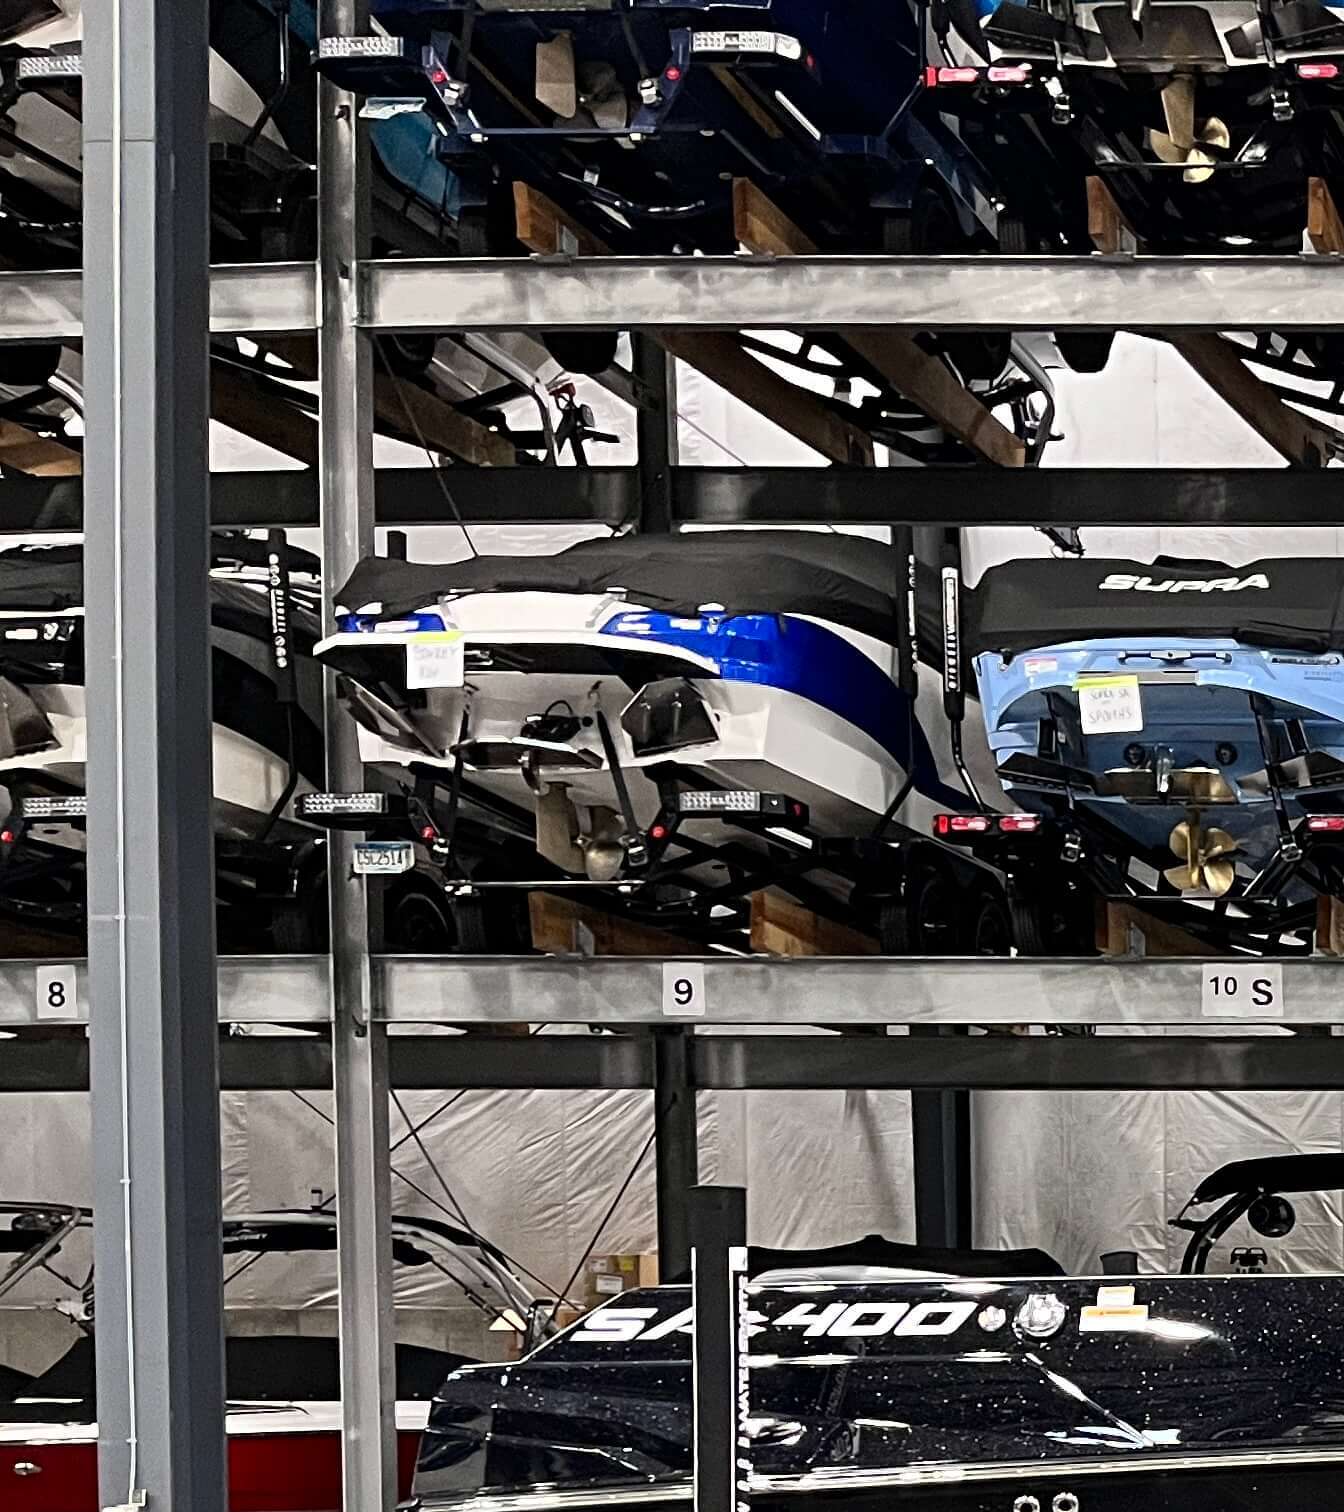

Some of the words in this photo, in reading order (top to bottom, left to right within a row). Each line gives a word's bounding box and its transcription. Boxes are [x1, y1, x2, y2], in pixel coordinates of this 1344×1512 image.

[1098, 573, 1270, 593] SUPRA
[48, 981, 66, 1008] 8
[674, 978, 693, 1005] 9
[1209, 976, 1238, 996] 10
[1251, 978, 1274, 1006] S
[772, 1302, 978, 1337] 400
